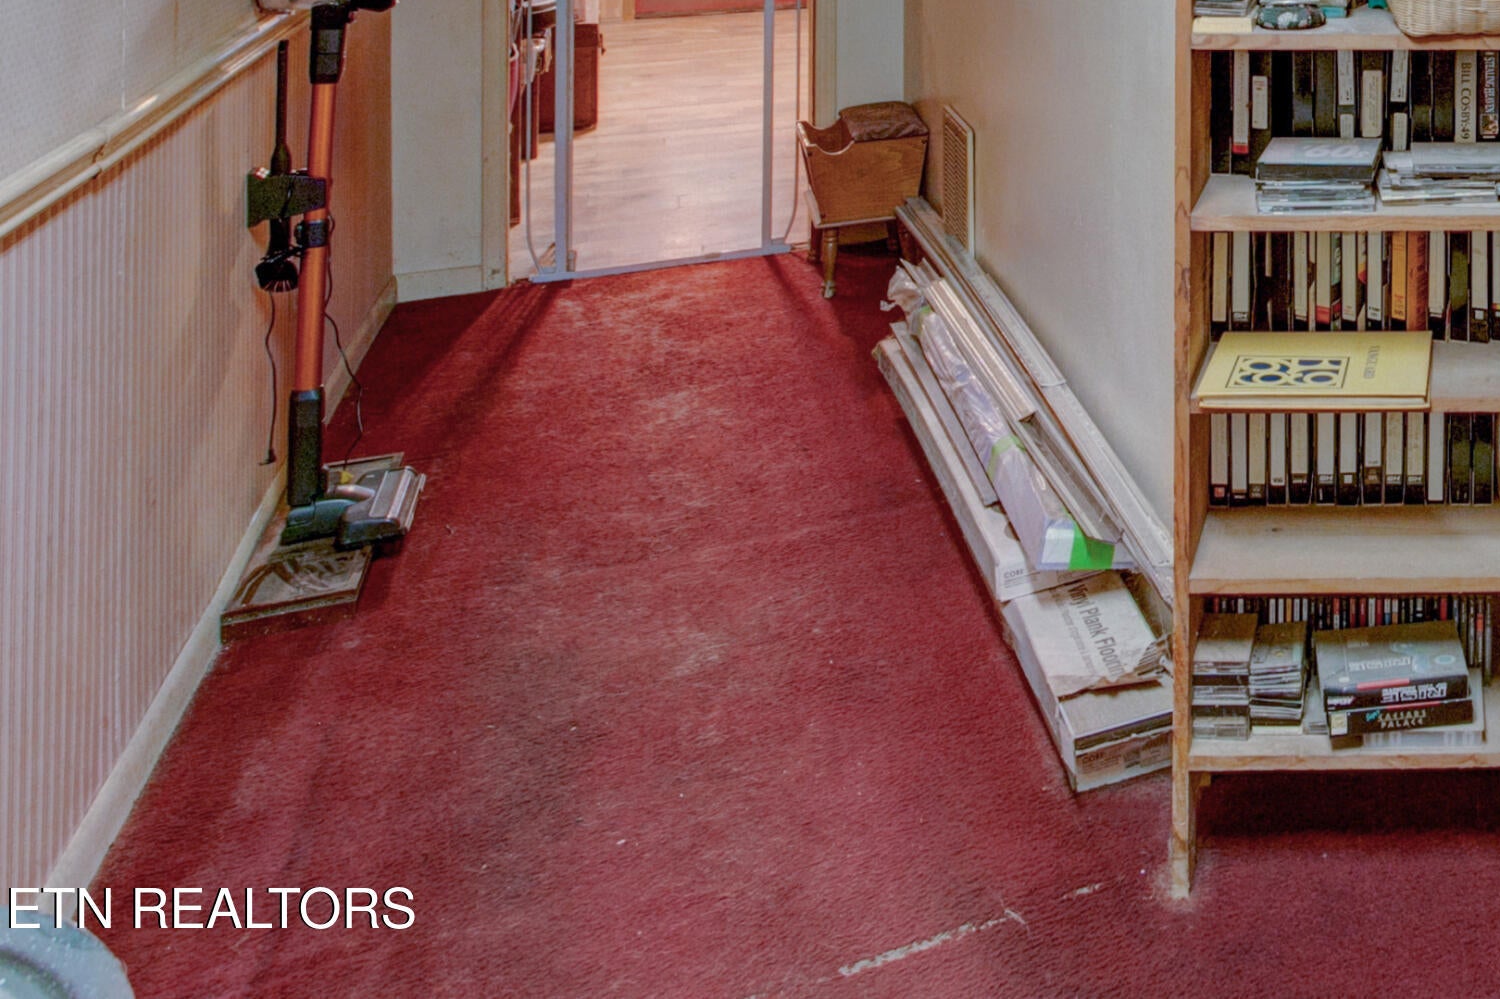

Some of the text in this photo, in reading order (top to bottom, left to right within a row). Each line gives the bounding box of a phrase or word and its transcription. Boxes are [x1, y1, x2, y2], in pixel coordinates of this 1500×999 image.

[1460, 62, 1473, 84] BILL
[1067, 582, 1090, 608] Vinyl
[1080, 601, 1111, 638] Plank
[1096, 636, 1127, 678] Floorin
[1378, 709, 1428, 722] CAESARS
[1380, 718, 1424, 729] PALACE
